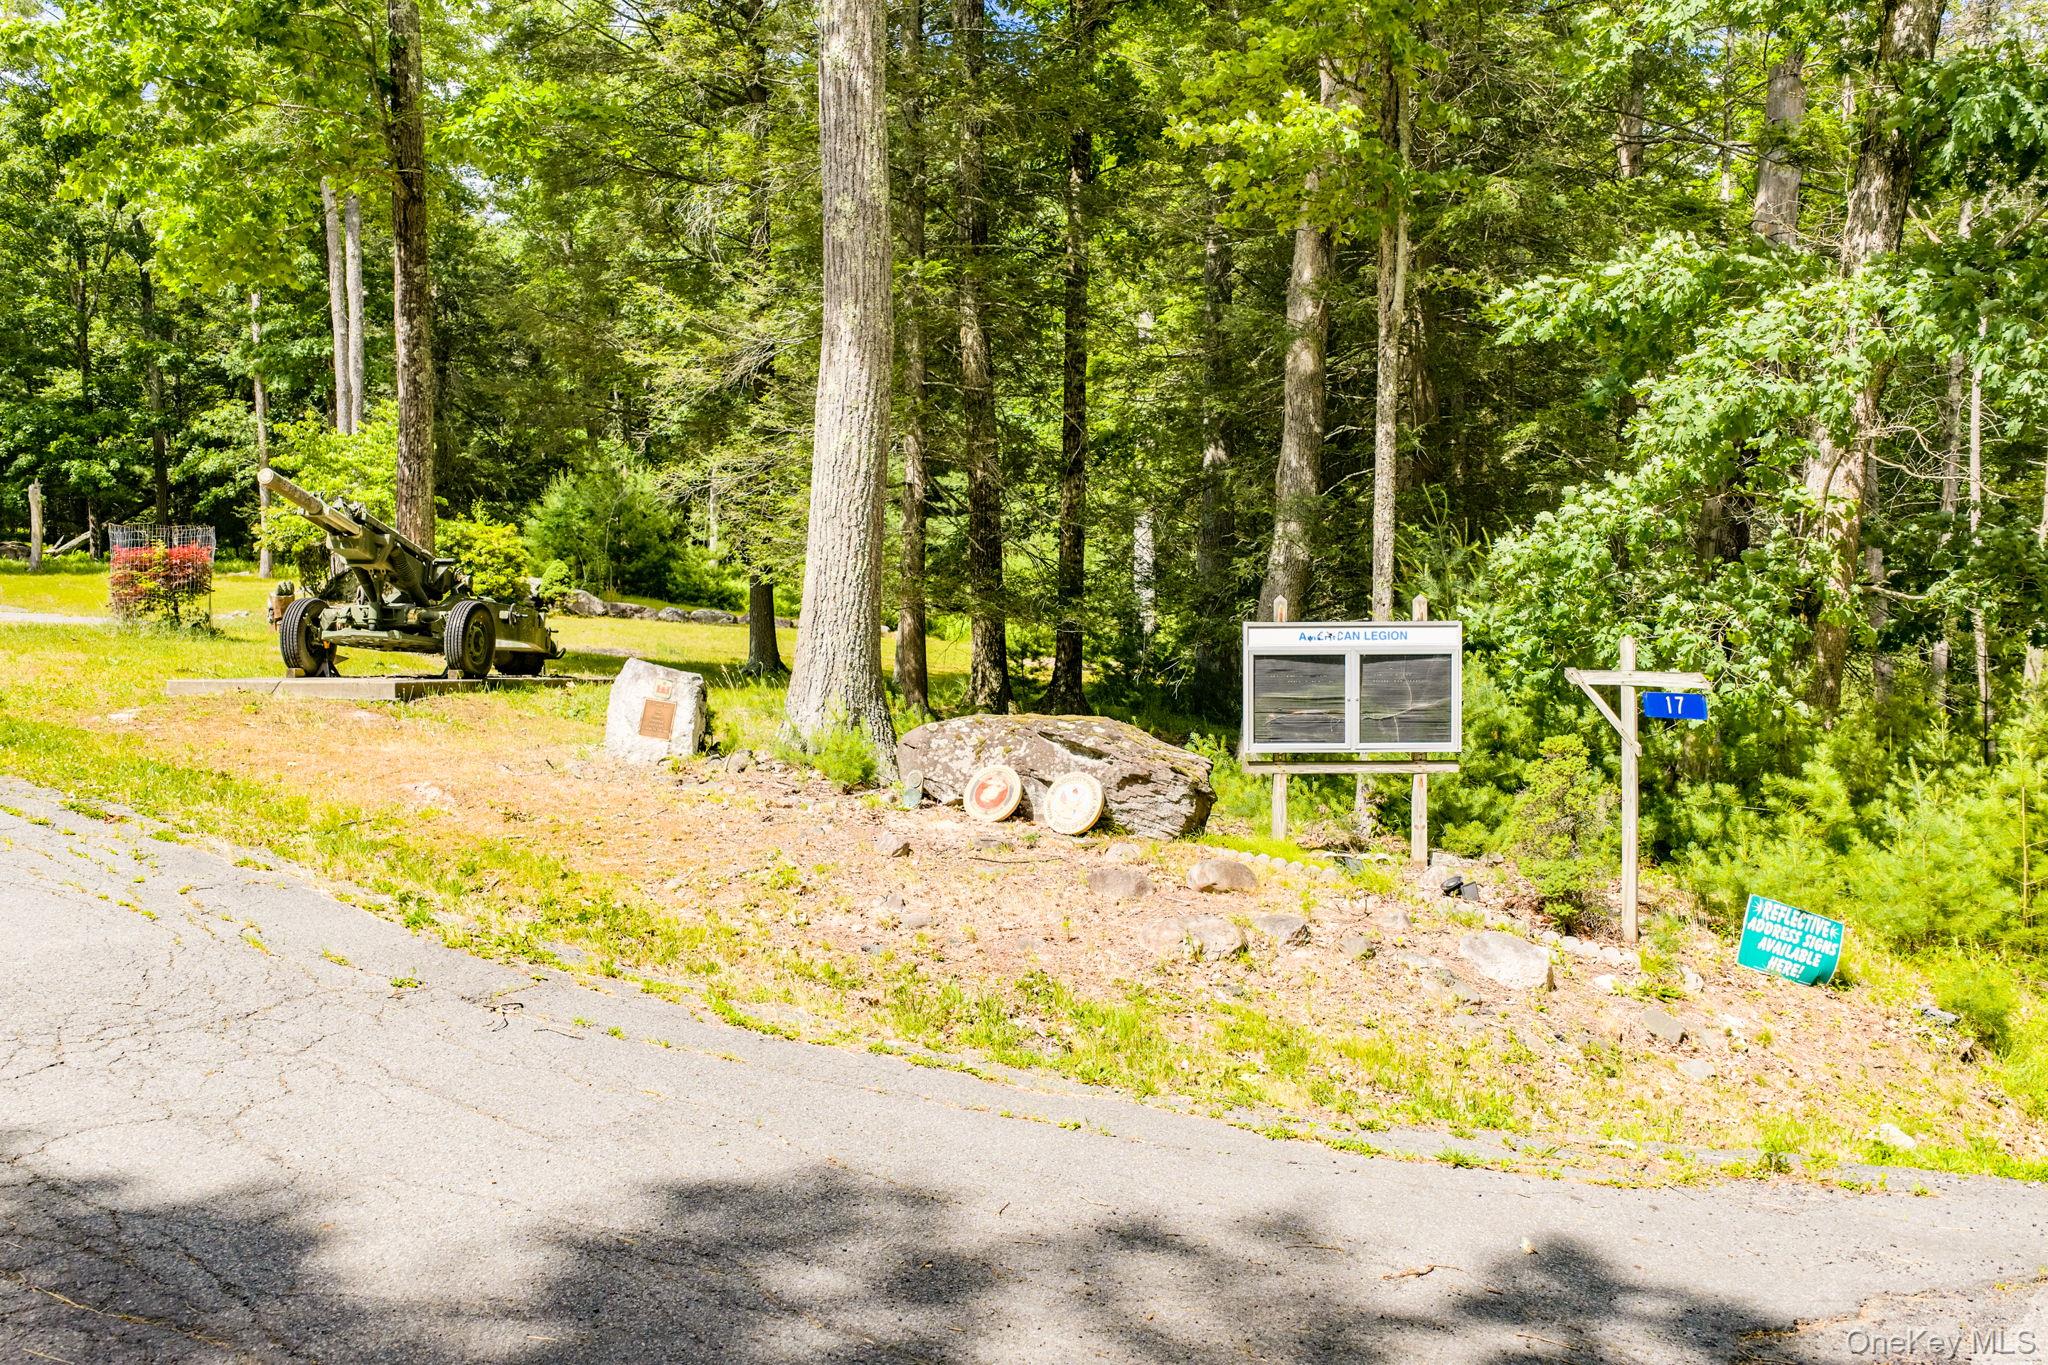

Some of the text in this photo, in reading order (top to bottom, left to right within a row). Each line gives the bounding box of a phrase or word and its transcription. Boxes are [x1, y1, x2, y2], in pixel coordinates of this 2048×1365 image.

[1364, 631, 1408, 641] LEGION
[1665, 695, 1684, 715] 17
[1762, 900, 1831, 938] REFLECTIVE
[1747, 917, 1839, 956] ADDRESS SIGNS
[1757, 936, 1822, 967] AVAILABLE
[1767, 956, 1806, 979] HERE!
